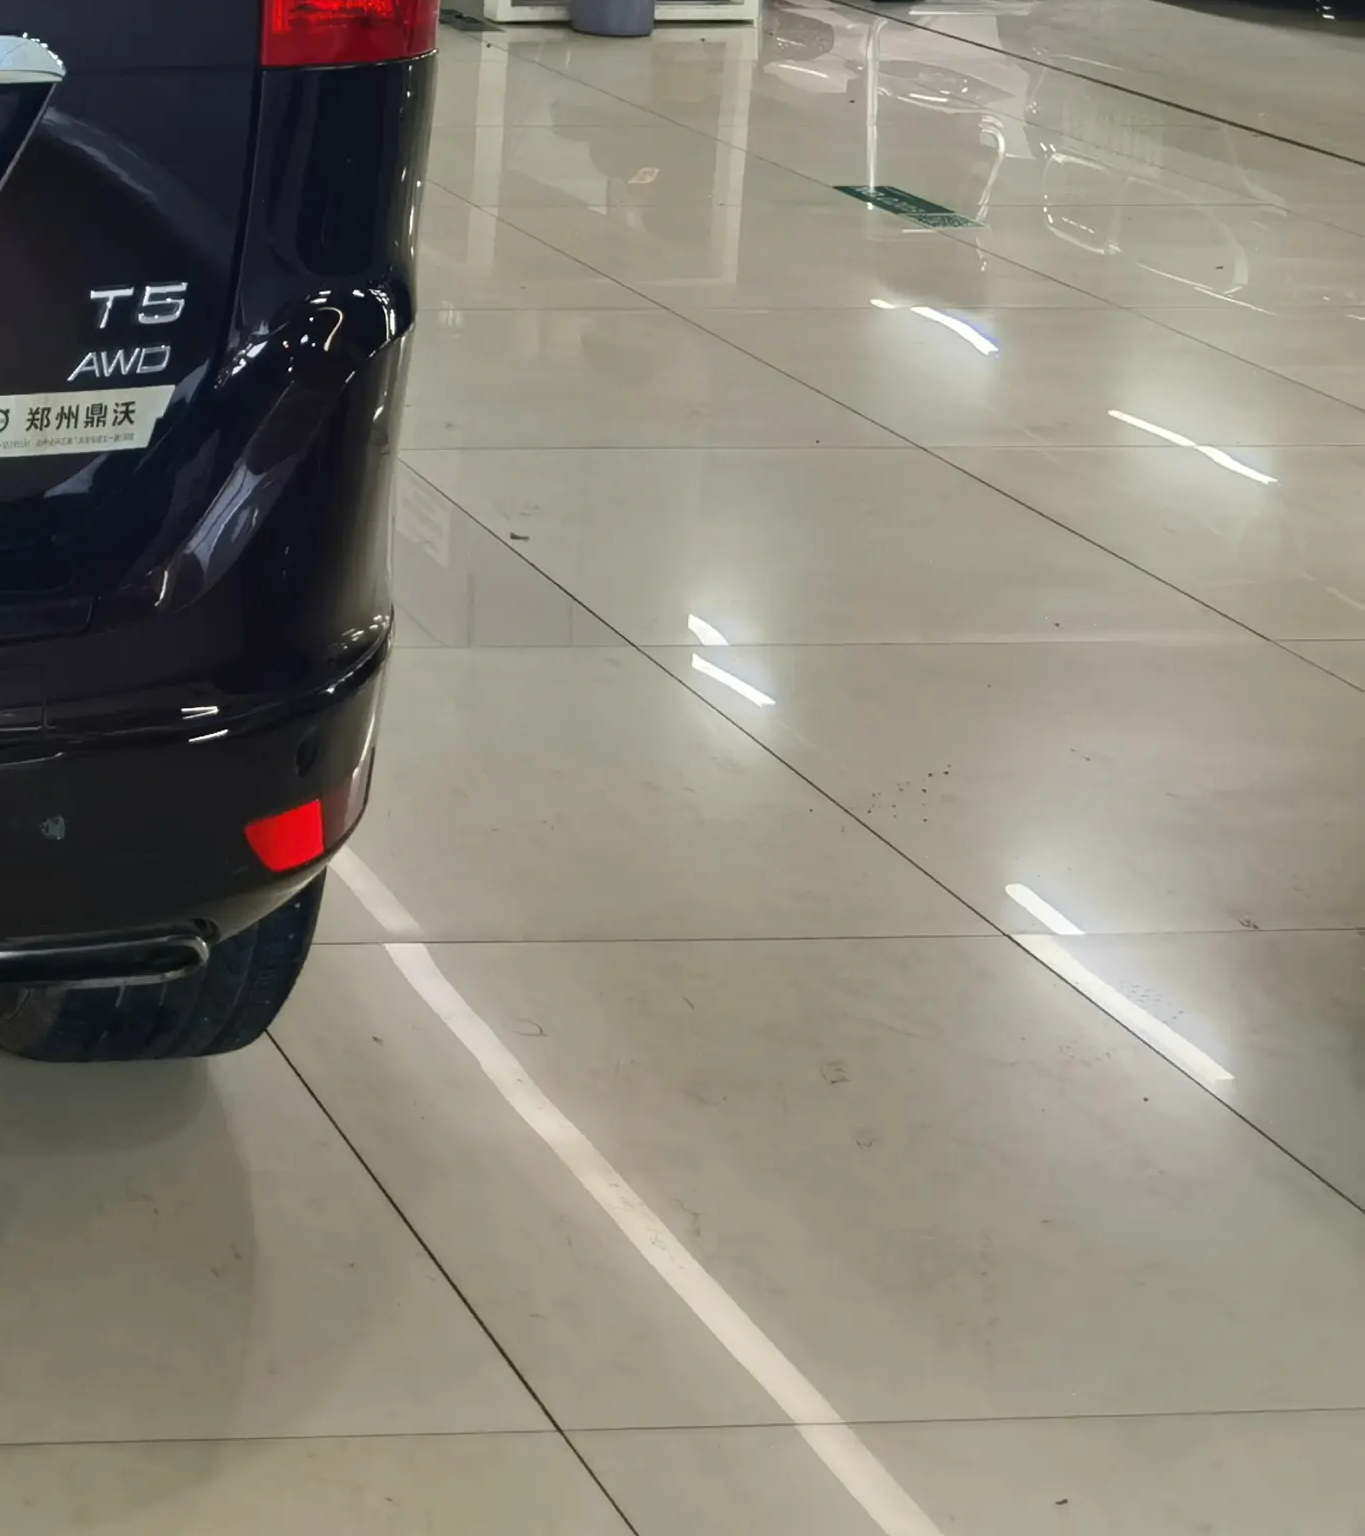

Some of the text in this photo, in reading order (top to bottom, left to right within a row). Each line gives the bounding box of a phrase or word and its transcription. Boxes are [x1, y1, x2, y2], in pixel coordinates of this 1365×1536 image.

[89, 282, 188, 329] T5
[67, 345, 170, 381] AWD
[25, 401, 136, 432] 郑州鼎沃
